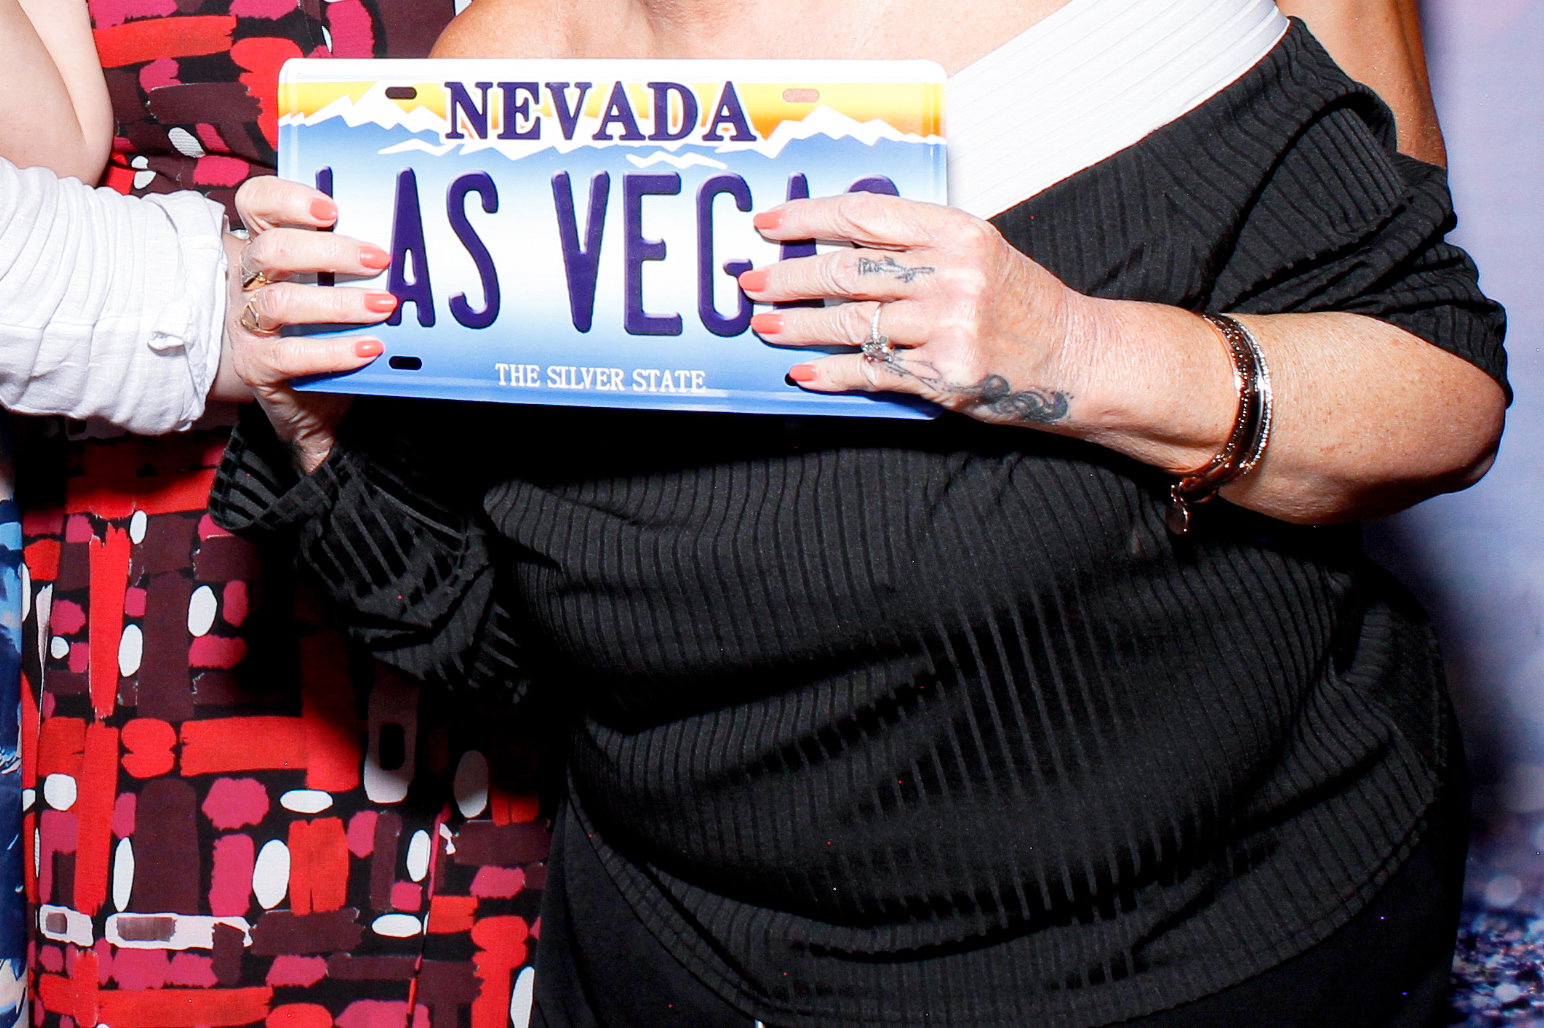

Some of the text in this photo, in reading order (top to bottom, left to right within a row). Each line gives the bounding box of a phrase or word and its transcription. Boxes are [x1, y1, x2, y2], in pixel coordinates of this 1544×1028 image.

[444, 80, 757, 142] NEVADA
[551, 170, 902, 337] VEG
[494, 363, 707, 394] THE SILVER STATE
